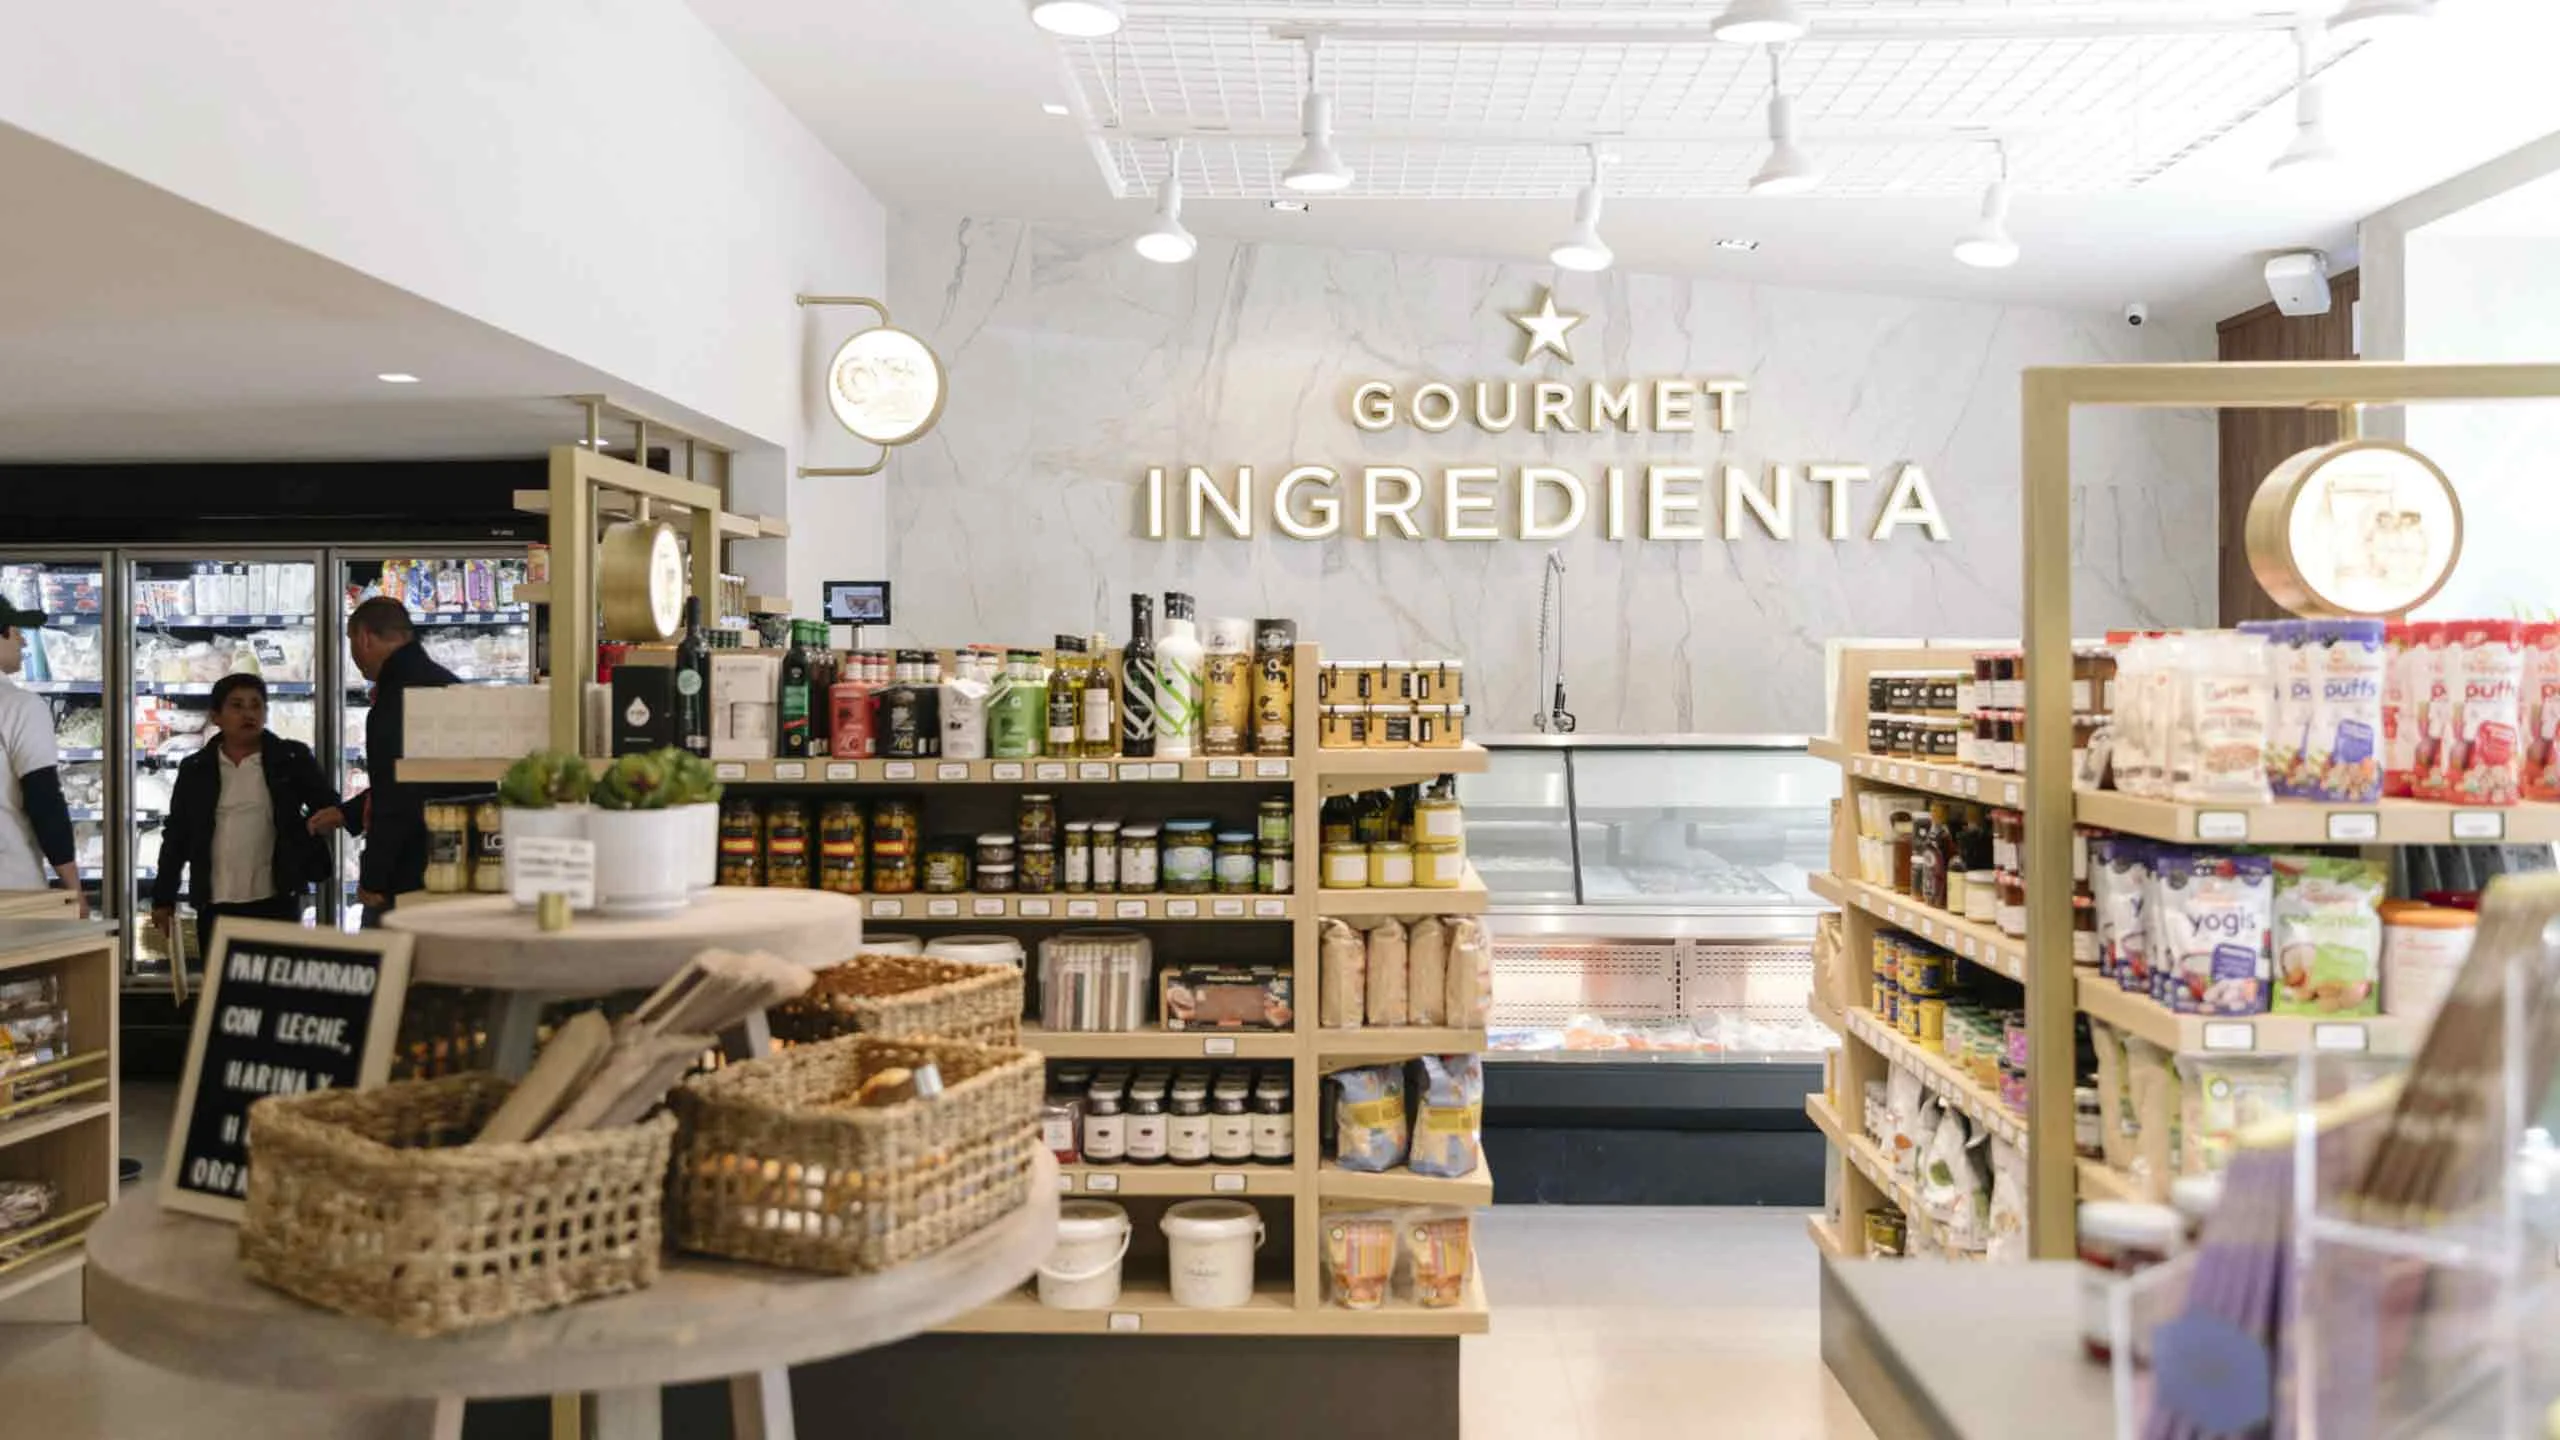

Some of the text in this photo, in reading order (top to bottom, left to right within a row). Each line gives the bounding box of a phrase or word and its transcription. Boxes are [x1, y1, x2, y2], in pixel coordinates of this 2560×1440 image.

[1351, 380, 1749, 434] GOURMET
[1144, 464, 1952, 541] INGREDIENTA
[2323, 679, 2377, 700] puffs
[2186, 905, 2257, 938] yogis
[229, 952, 376, 996] PAN ELABORADO
[222, 1005, 351, 1055] CON LECHE,
[225, 1060, 307, 1095] HARINA
